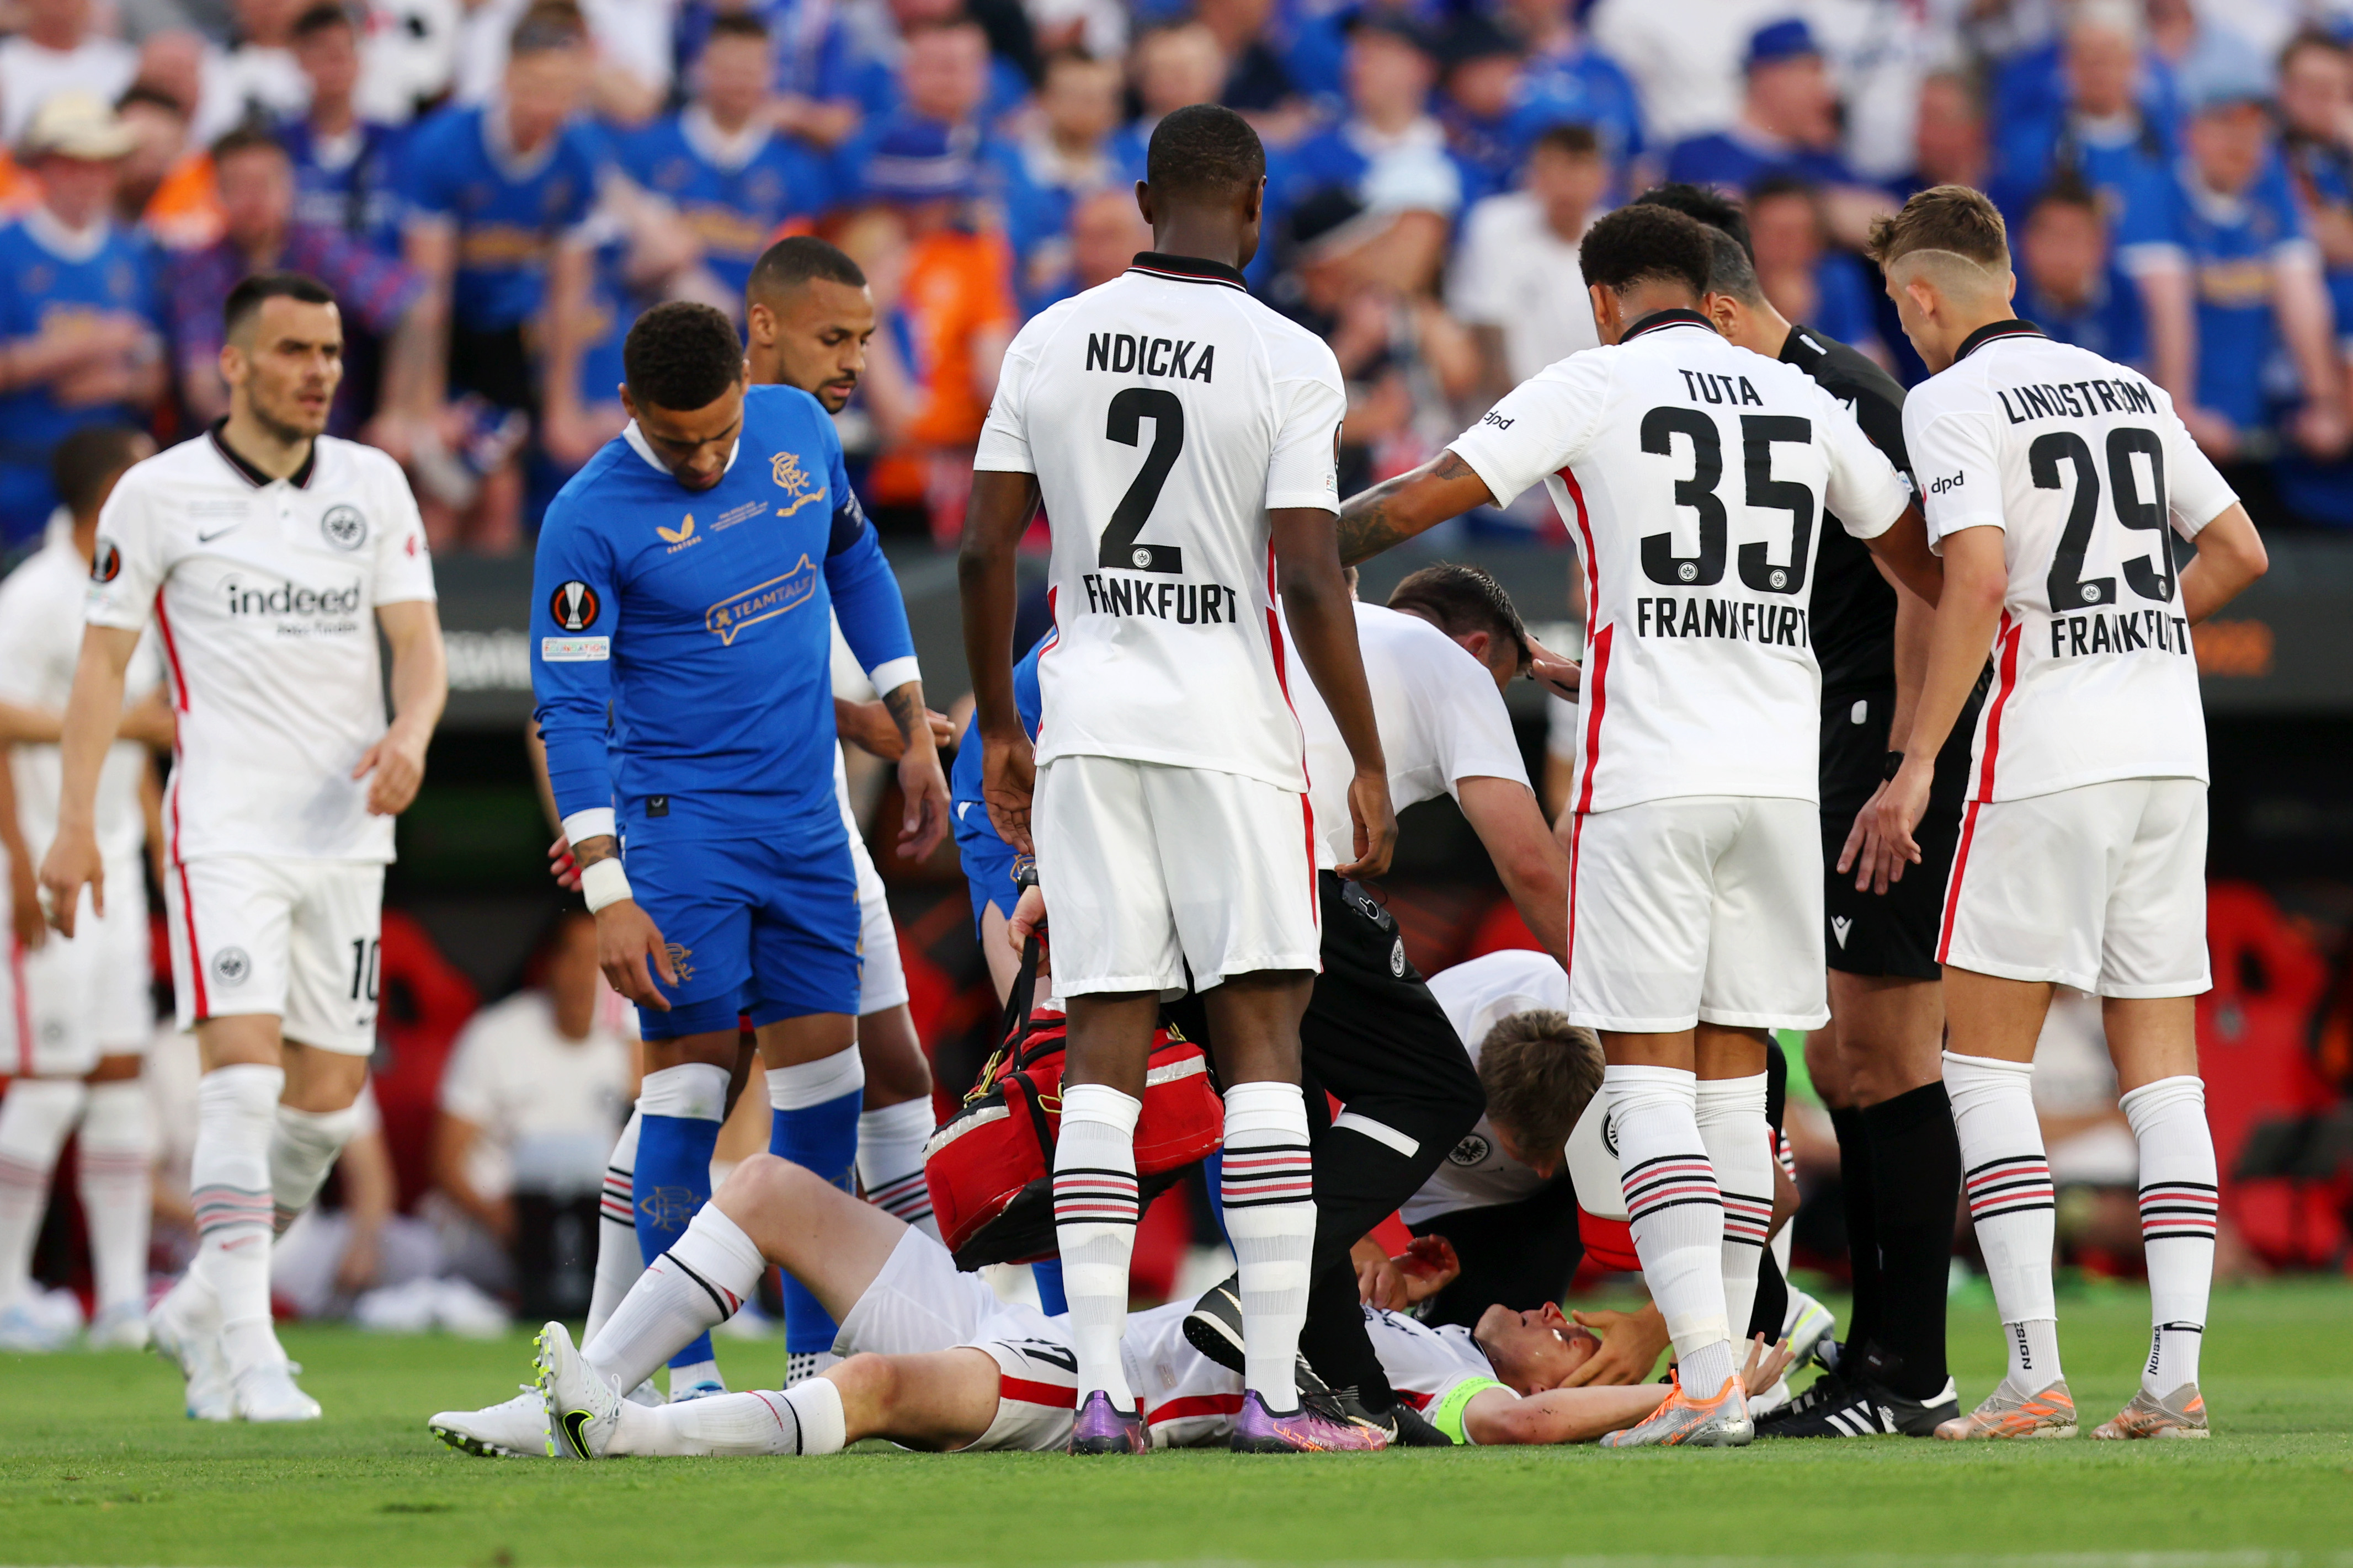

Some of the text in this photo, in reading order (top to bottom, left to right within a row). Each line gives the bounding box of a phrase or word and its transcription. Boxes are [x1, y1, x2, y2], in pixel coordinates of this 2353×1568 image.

[1086, 332, 1215, 383] NDICKA
[1678, 369, 1764, 406] TUTA
[1997, 377, 2158, 425] LINDSTRØM
[1483, 410, 1515, 430] dpd
[1098, 387, 1184, 574] 2
[1640, 406, 1814, 595] 35
[1931, 470, 1964, 494] dpd
[2029, 428, 2174, 613] 29
[229, 575, 361, 615] indeed
[1082, 574, 1236, 625] FRNKFURT
[1637, 597, 1807, 648] FRANKFURT
